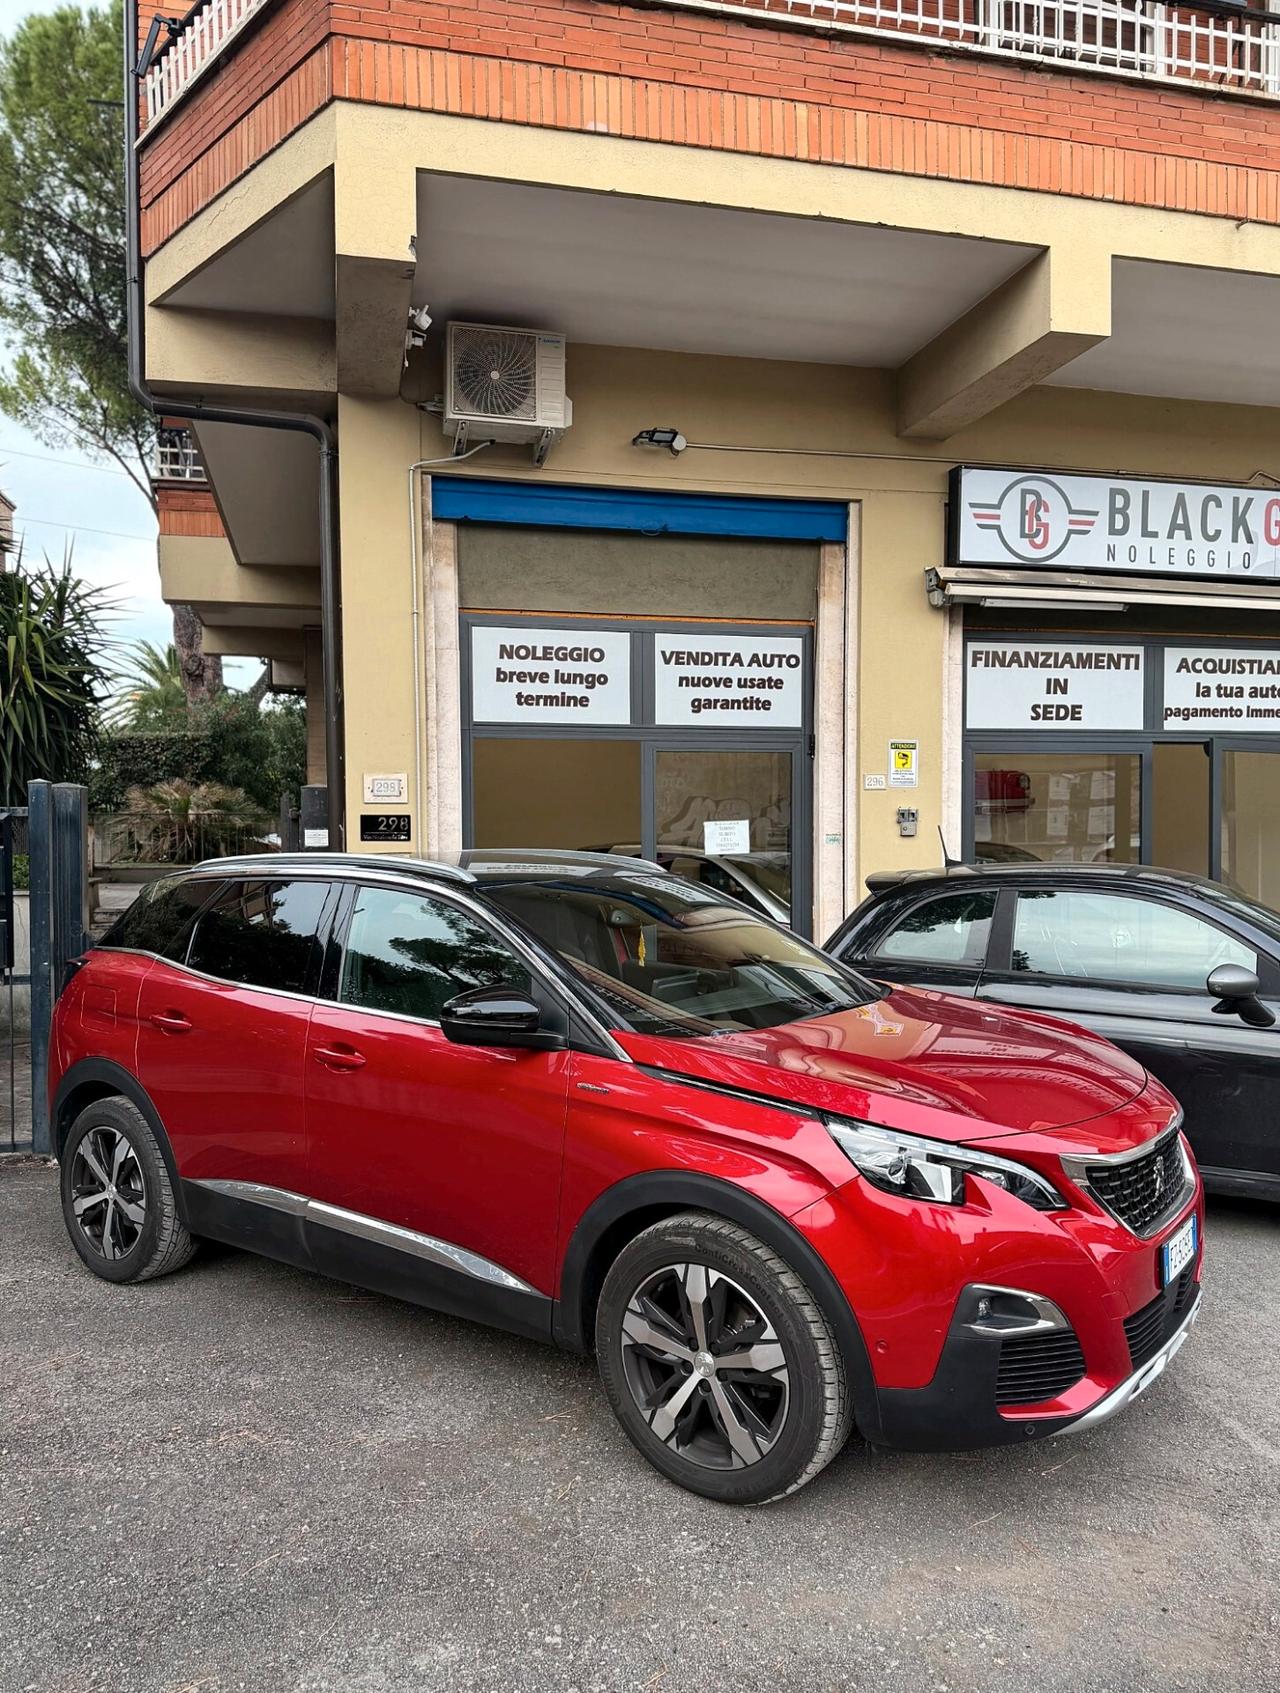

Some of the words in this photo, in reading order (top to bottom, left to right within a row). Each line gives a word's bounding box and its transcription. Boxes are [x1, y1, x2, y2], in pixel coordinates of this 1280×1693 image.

[1107, 544, 1250, 569] NOLEGGIO
[499, 644, 605, 662] NOLEGGIO
[660, 650, 744, 667] VENDITA
[747, 653, 800, 668] AUTO
[971, 650, 1140, 670] FINANZIAMENTI
[1176, 657, 1280, 675] ACQUISTIA
[496, 667, 549, 683] breve
[554, 669, 608, 689] lungo
[678, 676, 733, 688] nuove
[737, 676, 784, 689] usate
[1046, 678, 1068, 695] IN
[1196, 682, 1211, 698] la
[1215, 683, 1244, 698] tua
[516, 692, 589, 707] termine
[691, 696, 772, 713] garantite
[1030, 704, 1083, 721] SEDE
[1164, 705, 1243, 720] pagamento
[375, 782, 396, 793] 298
[866, 776, 884, 787] 296
[378, 817, 408, 831] 298
